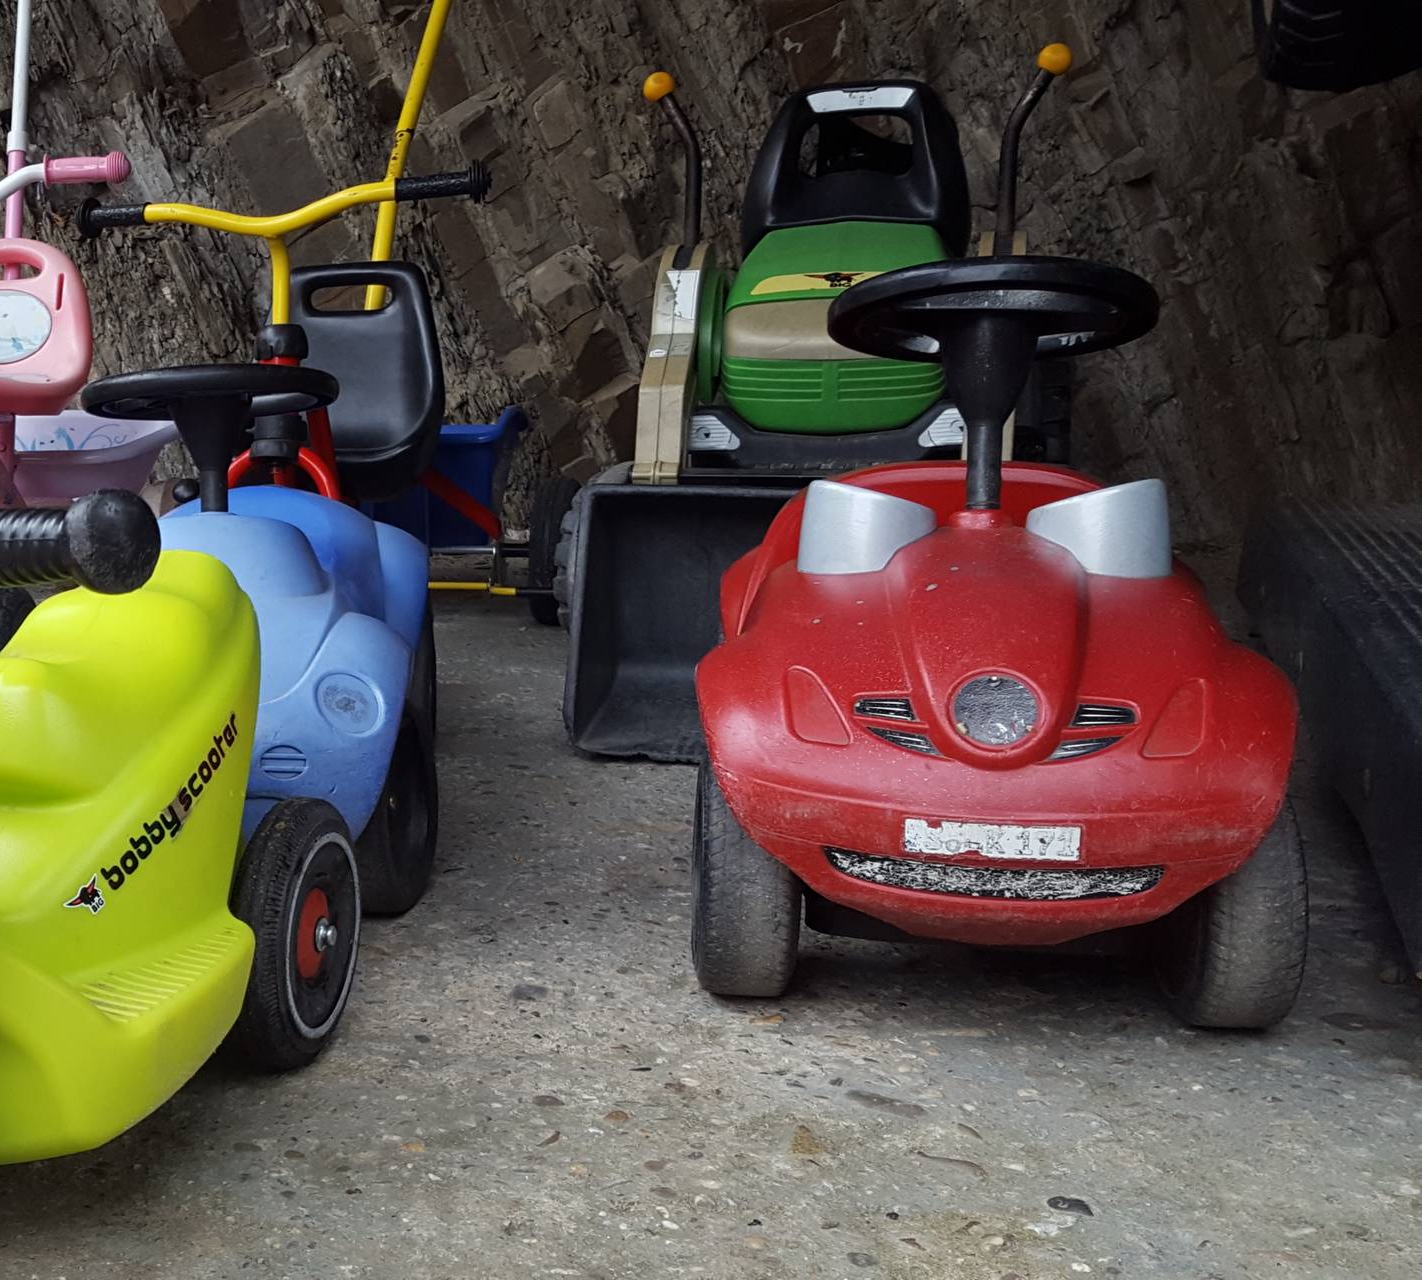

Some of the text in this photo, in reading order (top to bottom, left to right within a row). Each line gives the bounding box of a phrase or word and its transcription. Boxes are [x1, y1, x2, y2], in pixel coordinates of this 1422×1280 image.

[100, 713, 238, 891] bobby scooter
[91, 897, 105, 913] BIG
